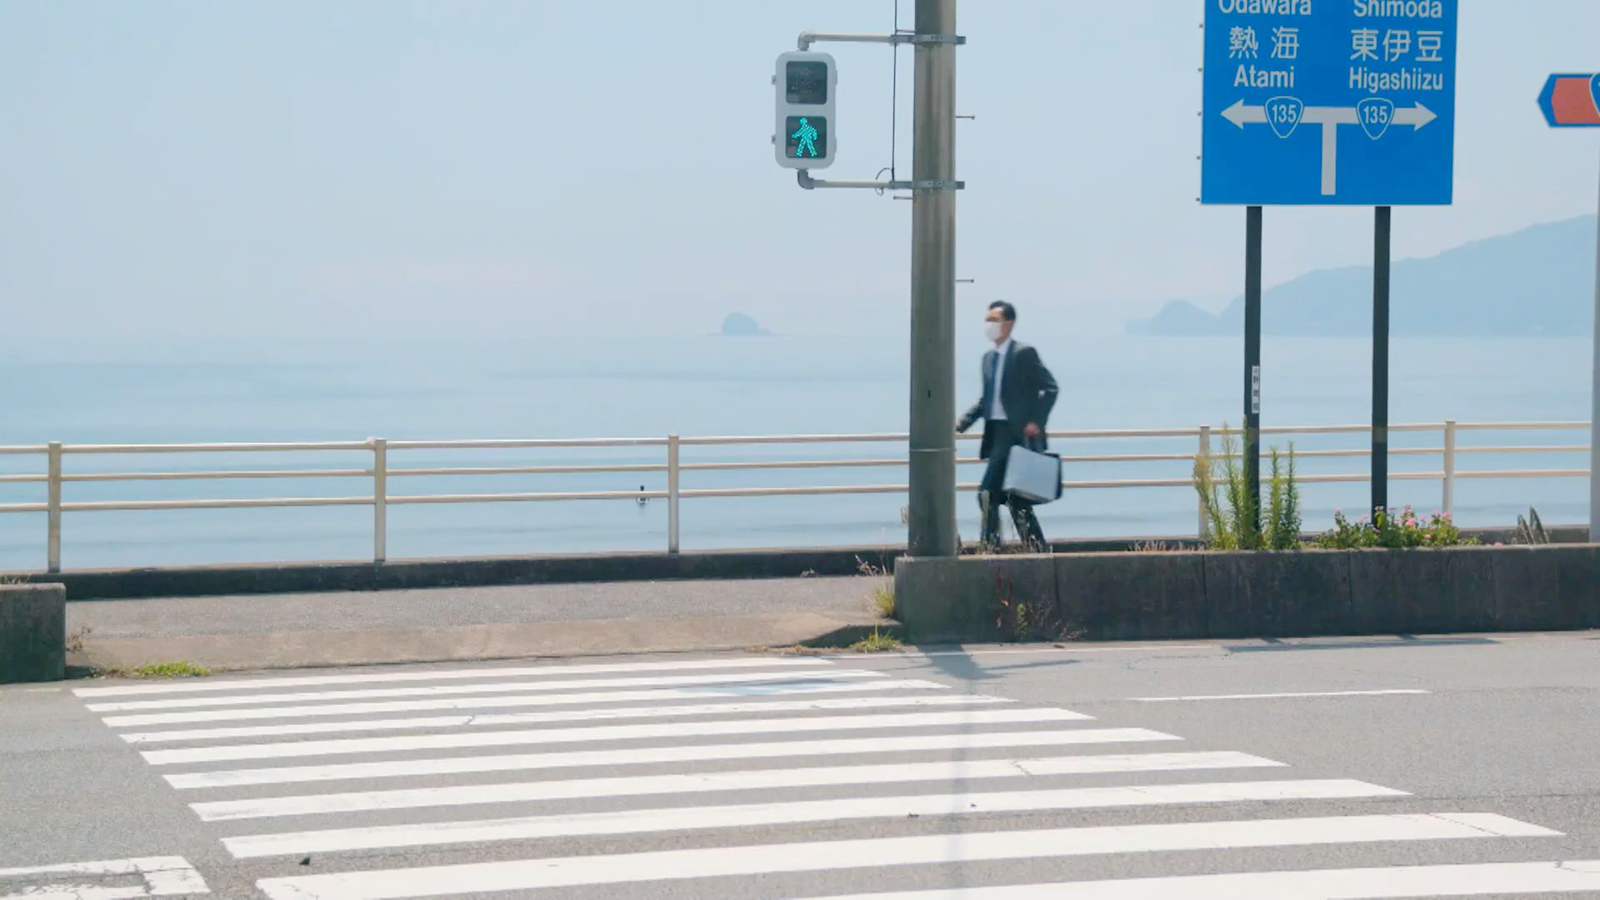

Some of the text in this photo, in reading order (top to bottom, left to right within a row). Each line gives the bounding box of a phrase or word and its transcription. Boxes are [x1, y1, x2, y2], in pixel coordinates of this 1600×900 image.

[1218, 0, 1312, 15] Odawara
[1353, 0, 1443, 18] Shimoda
[1229, 26, 1300, 59] 熱海
[1350, 27, 1443, 62] 東伊豆
[1233, 64, 1295, 88] Atami
[1349, 66, 1443, 93] Higashiizu
[1271, 104, 1297, 123] 135
[1363, 106, 1388, 124] 135
